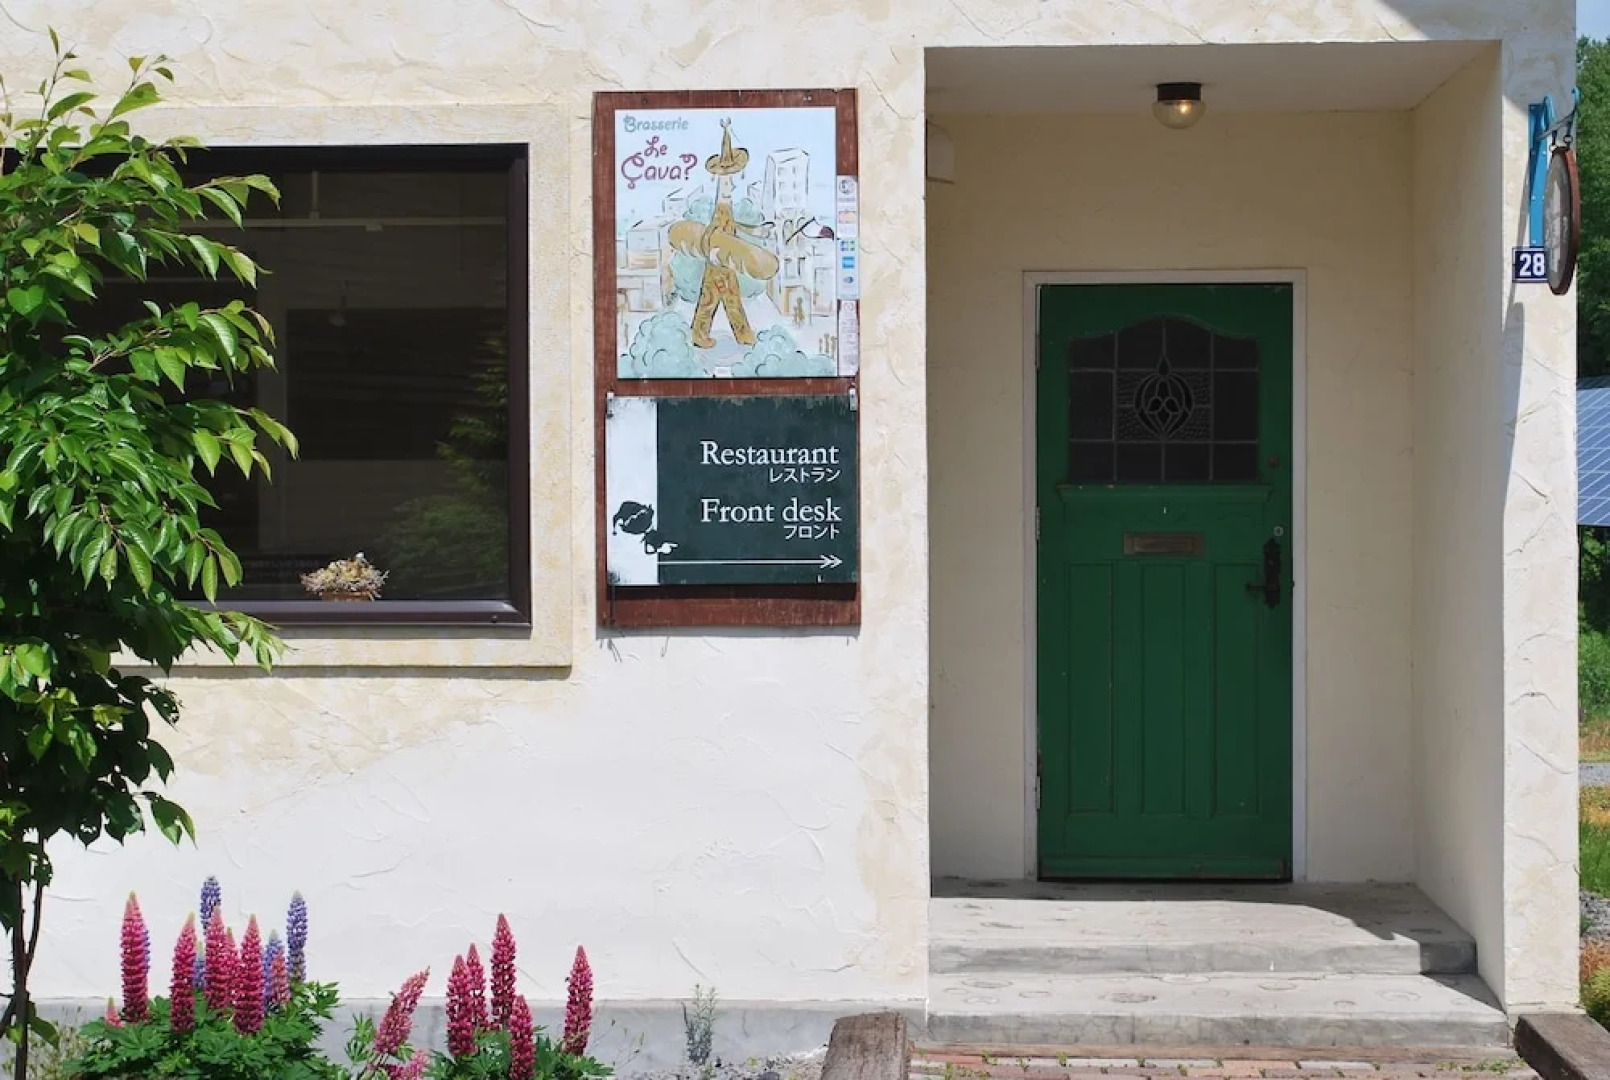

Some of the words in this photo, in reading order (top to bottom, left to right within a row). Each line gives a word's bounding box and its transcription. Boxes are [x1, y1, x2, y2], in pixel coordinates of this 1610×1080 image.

[623, 115, 689, 132] Brasserie
[644, 136, 668, 157] Le
[1519, 253, 1545, 276] 28
[700, 440, 840, 465] Restaurant
[769, 467, 841, 483] レストラン
[701, 498, 775, 523] Front
[782, 497, 842, 523] desk
[783, 524, 840, 540] フロント
